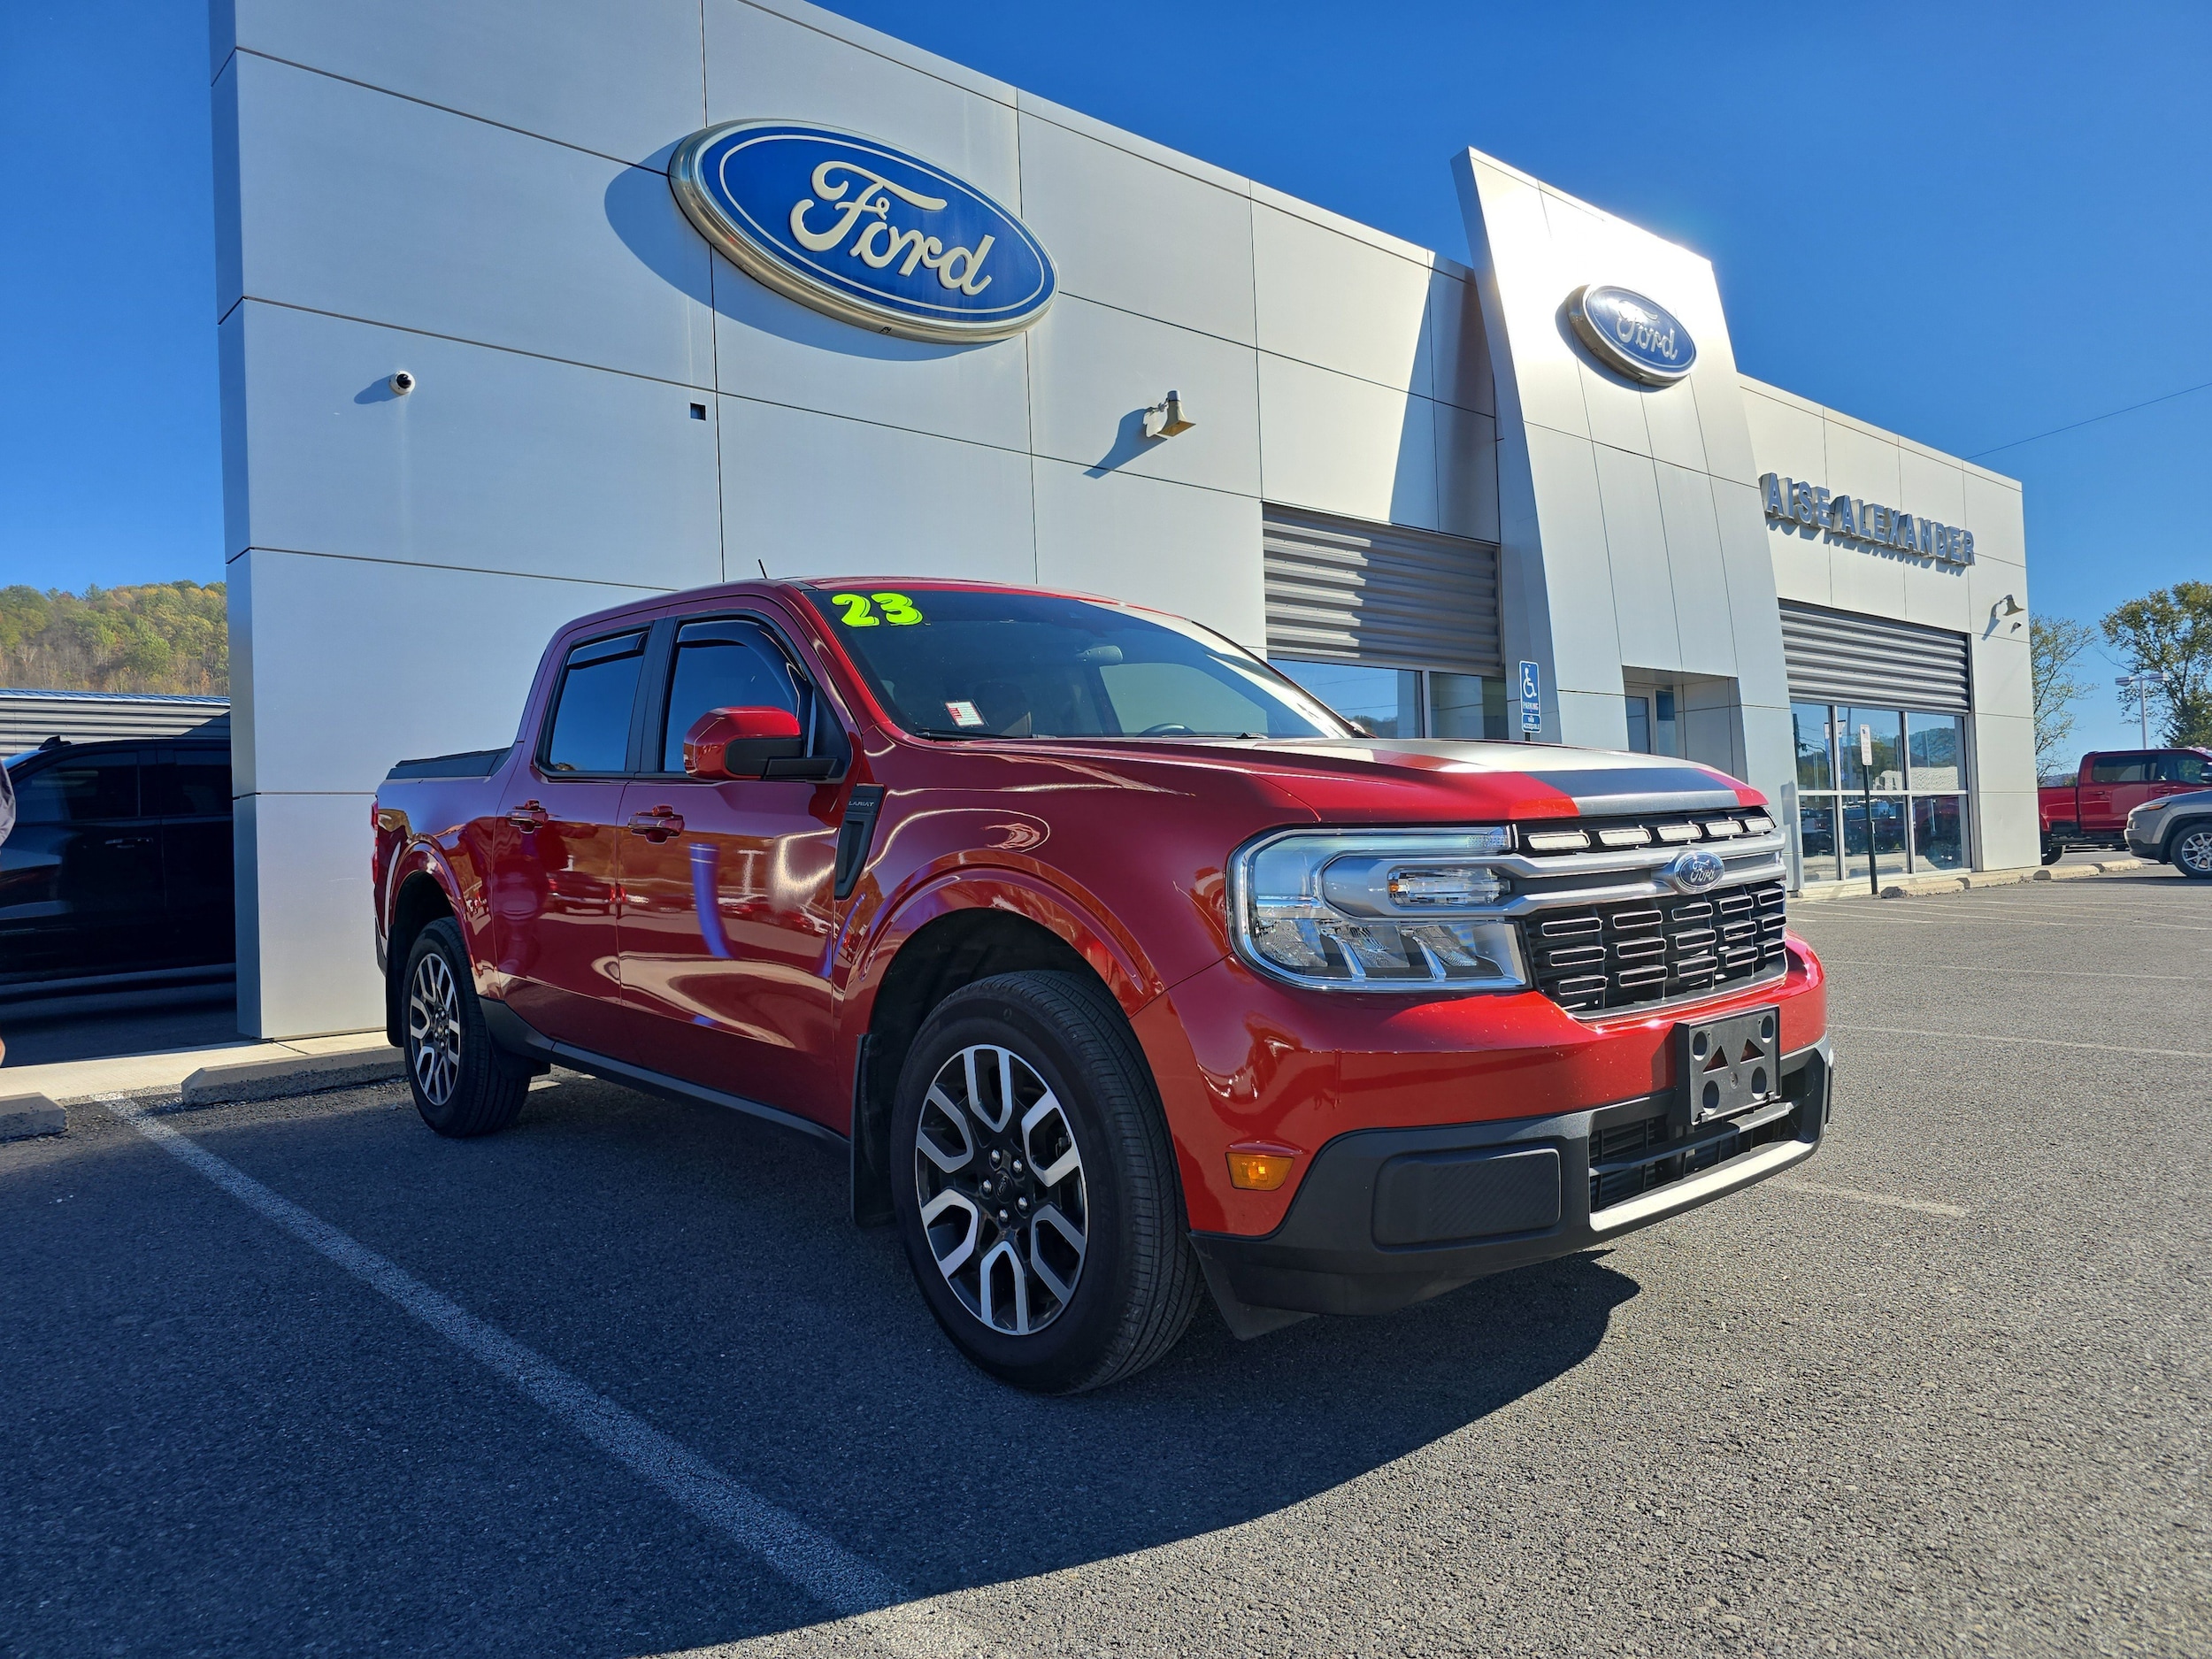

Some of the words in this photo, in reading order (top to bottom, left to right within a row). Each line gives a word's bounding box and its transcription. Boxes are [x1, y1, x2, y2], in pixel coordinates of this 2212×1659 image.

[790, 161, 995, 296] Ford
[1831, 495, 1976, 566] ALEXANDER
[832, 593, 923, 627] 23
[1690, 860, 1717, 883] Ford
